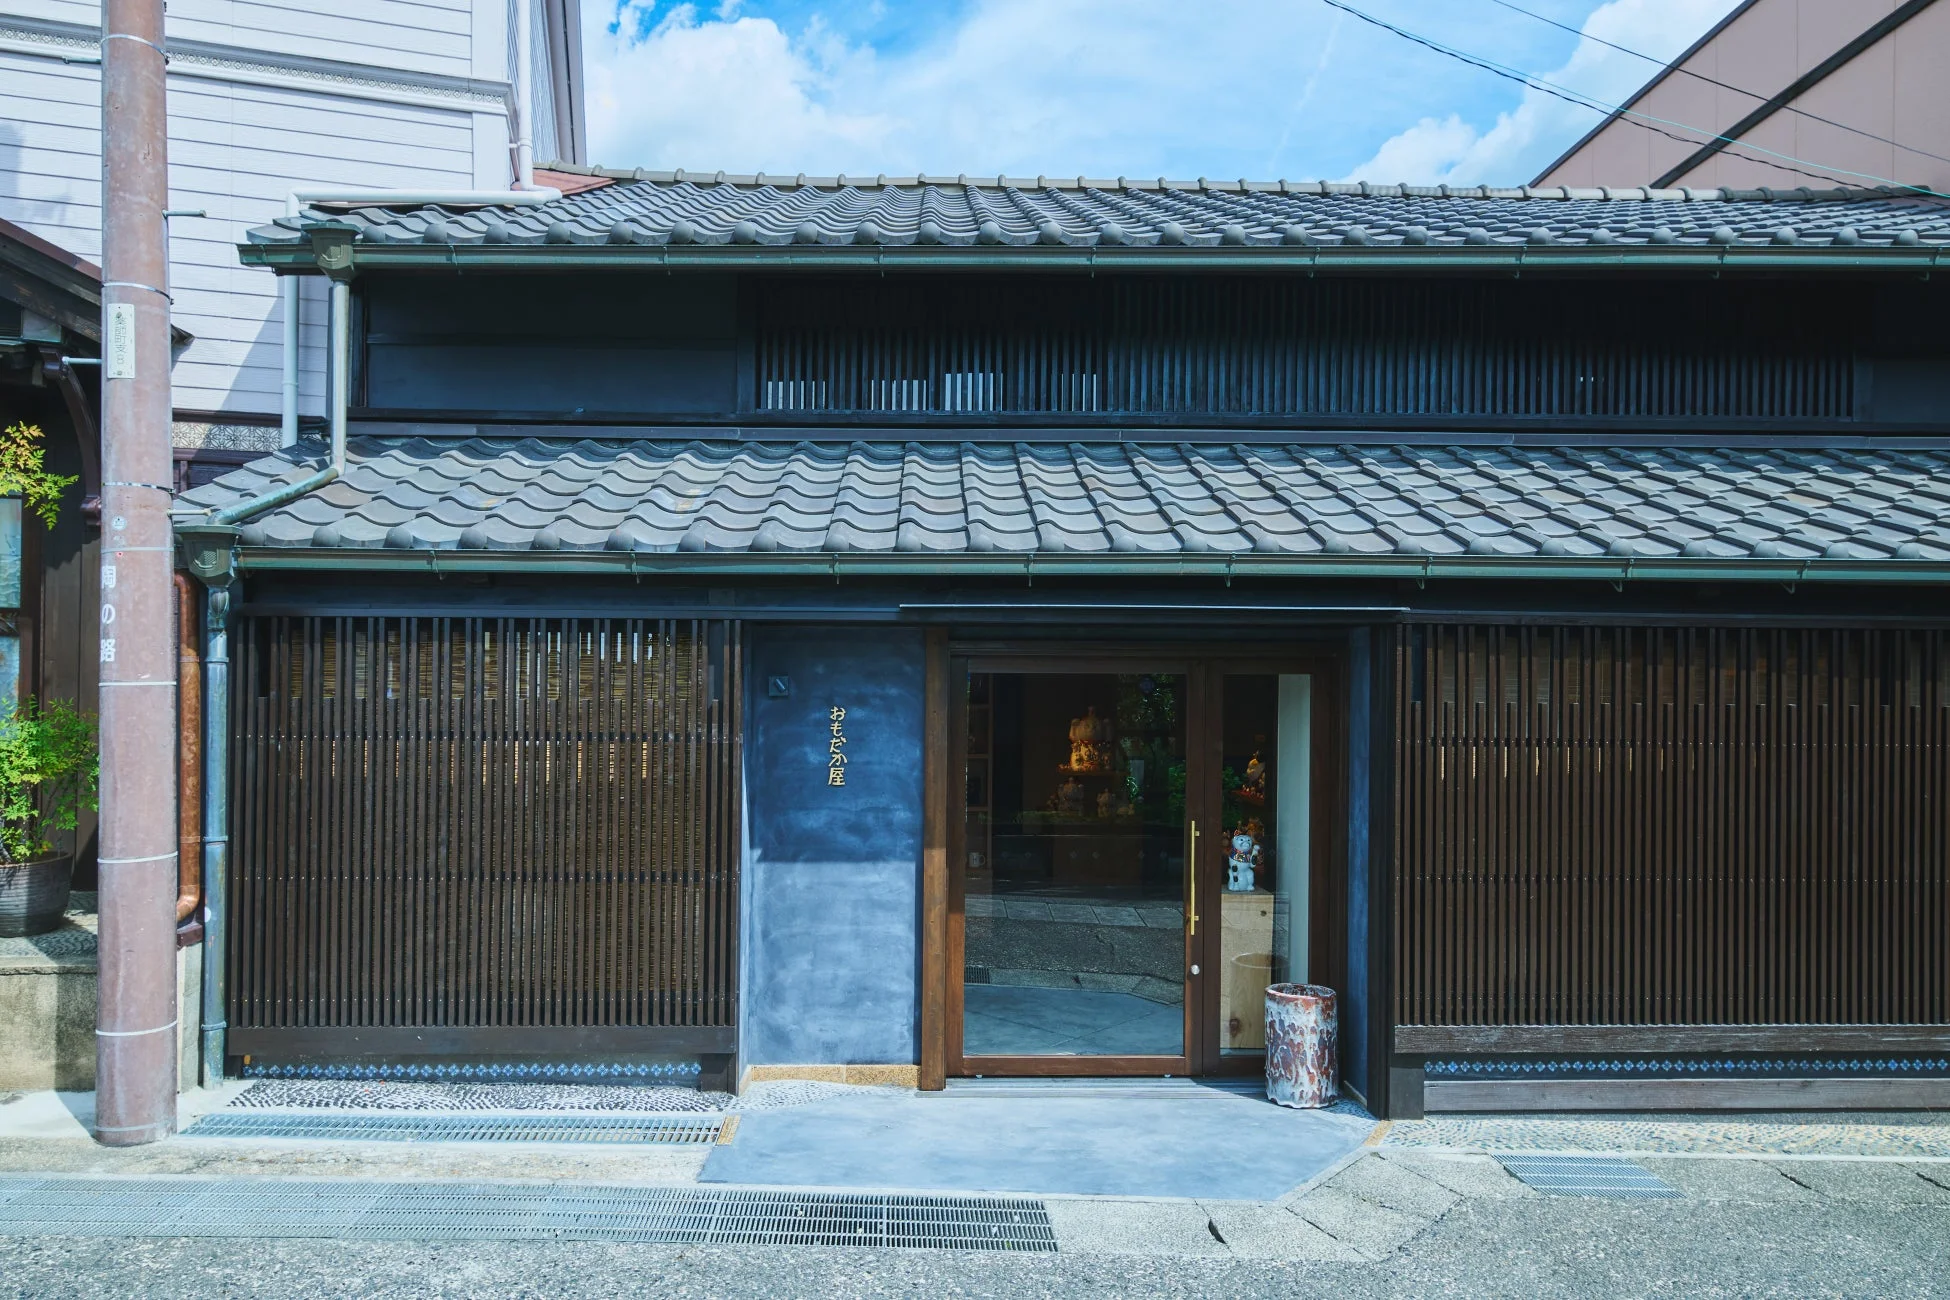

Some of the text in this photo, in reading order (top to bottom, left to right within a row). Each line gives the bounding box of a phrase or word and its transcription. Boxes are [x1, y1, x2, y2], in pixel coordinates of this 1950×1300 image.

[828, 705, 848, 786] おもだか屋
